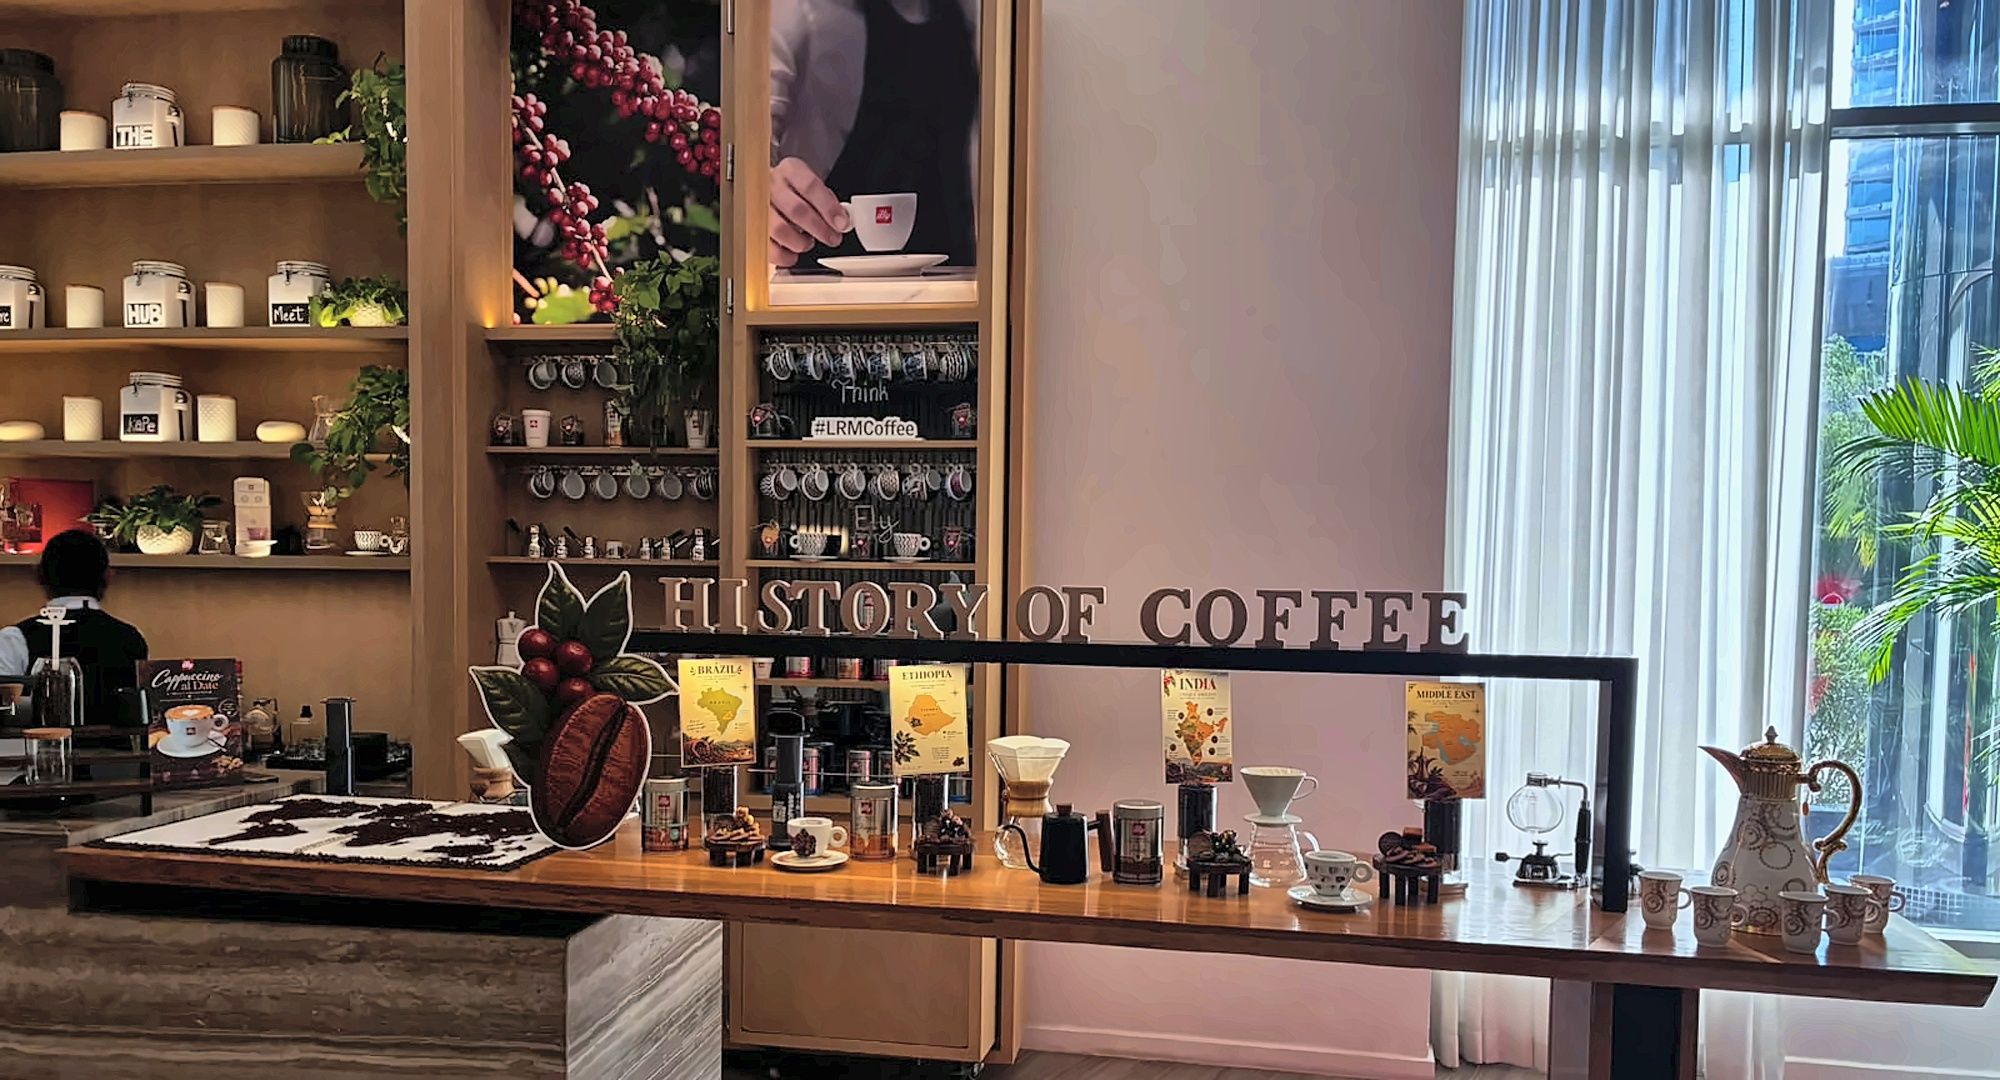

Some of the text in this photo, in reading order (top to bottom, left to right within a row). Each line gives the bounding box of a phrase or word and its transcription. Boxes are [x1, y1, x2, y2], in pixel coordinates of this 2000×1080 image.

[117, 126, 153, 146] THE
[127, 304, 162, 325] HUB
[273, 305, 305, 323] Meet
[831, 379, 889, 403] Think
[815, 420, 915, 436] #LRMCoffee
[658, 577, 1470, 653] HISTORY OF COFFEE
[698, 664, 737, 675] BRAZIL
[902, 670, 952, 680] ETHIOPIA
[151, 669, 223, 692] Cappuccino
[180, 680, 219, 691] al Date
[1180, 678, 1217, 690] INDIA
[1417, 690, 1476, 699] MIDDLE EAST
